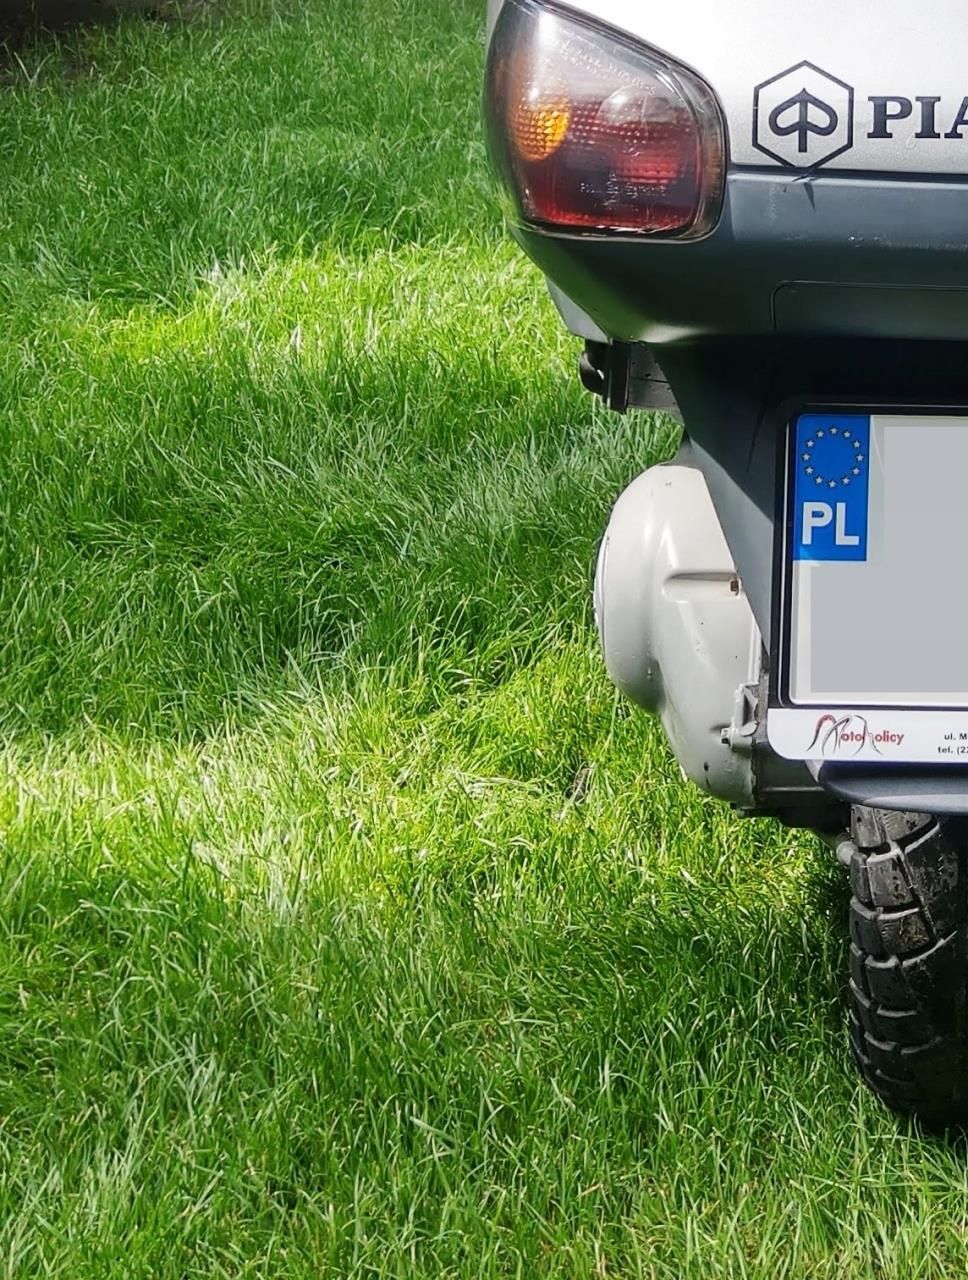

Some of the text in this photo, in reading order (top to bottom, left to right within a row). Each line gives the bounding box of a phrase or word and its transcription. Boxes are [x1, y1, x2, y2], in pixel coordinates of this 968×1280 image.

[802, 501, 860, 546] PL
[943, 732, 957, 741] ul.
[937, 745, 954, 754] tel.
